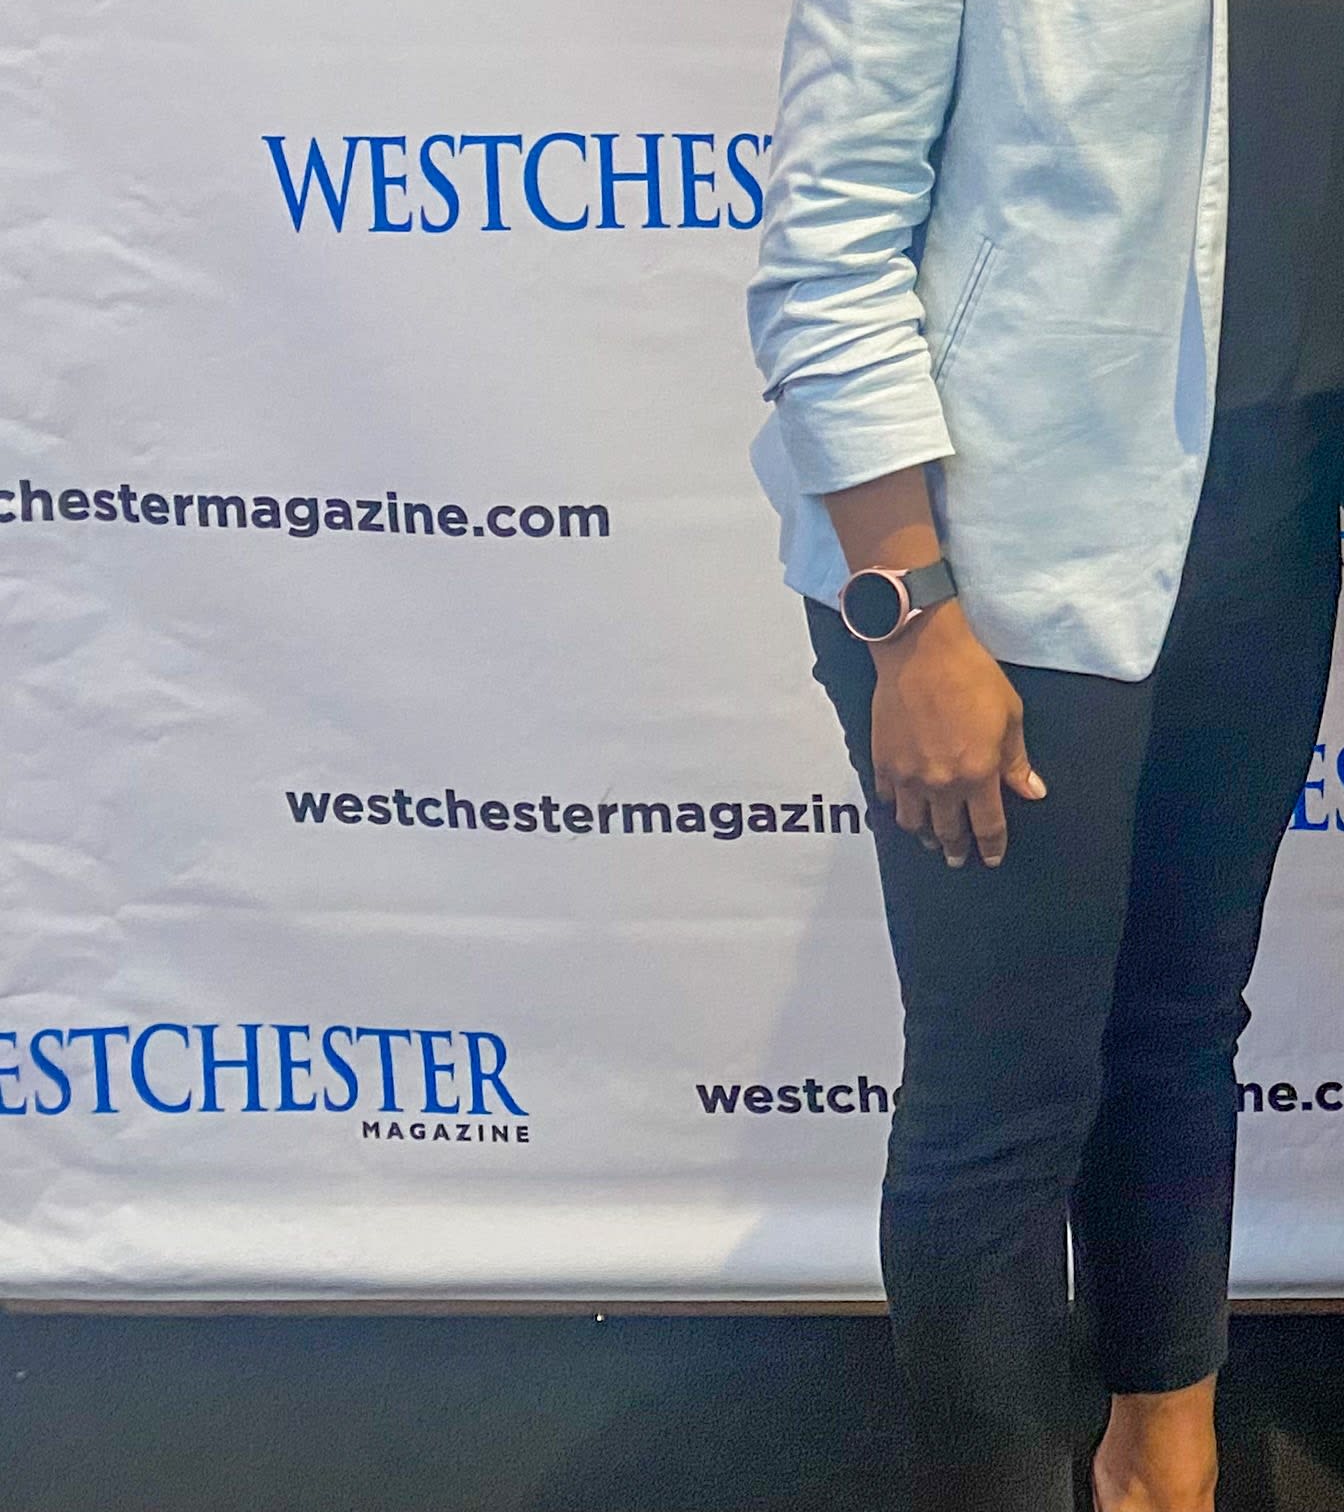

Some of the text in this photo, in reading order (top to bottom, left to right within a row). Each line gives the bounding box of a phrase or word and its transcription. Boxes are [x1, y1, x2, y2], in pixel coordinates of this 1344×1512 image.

[262, 133, 772, 234] WESTCHES
[286, 790, 874, 841] westchestermagazin
[364, 1123, 530, 1143] MAGAZINE
